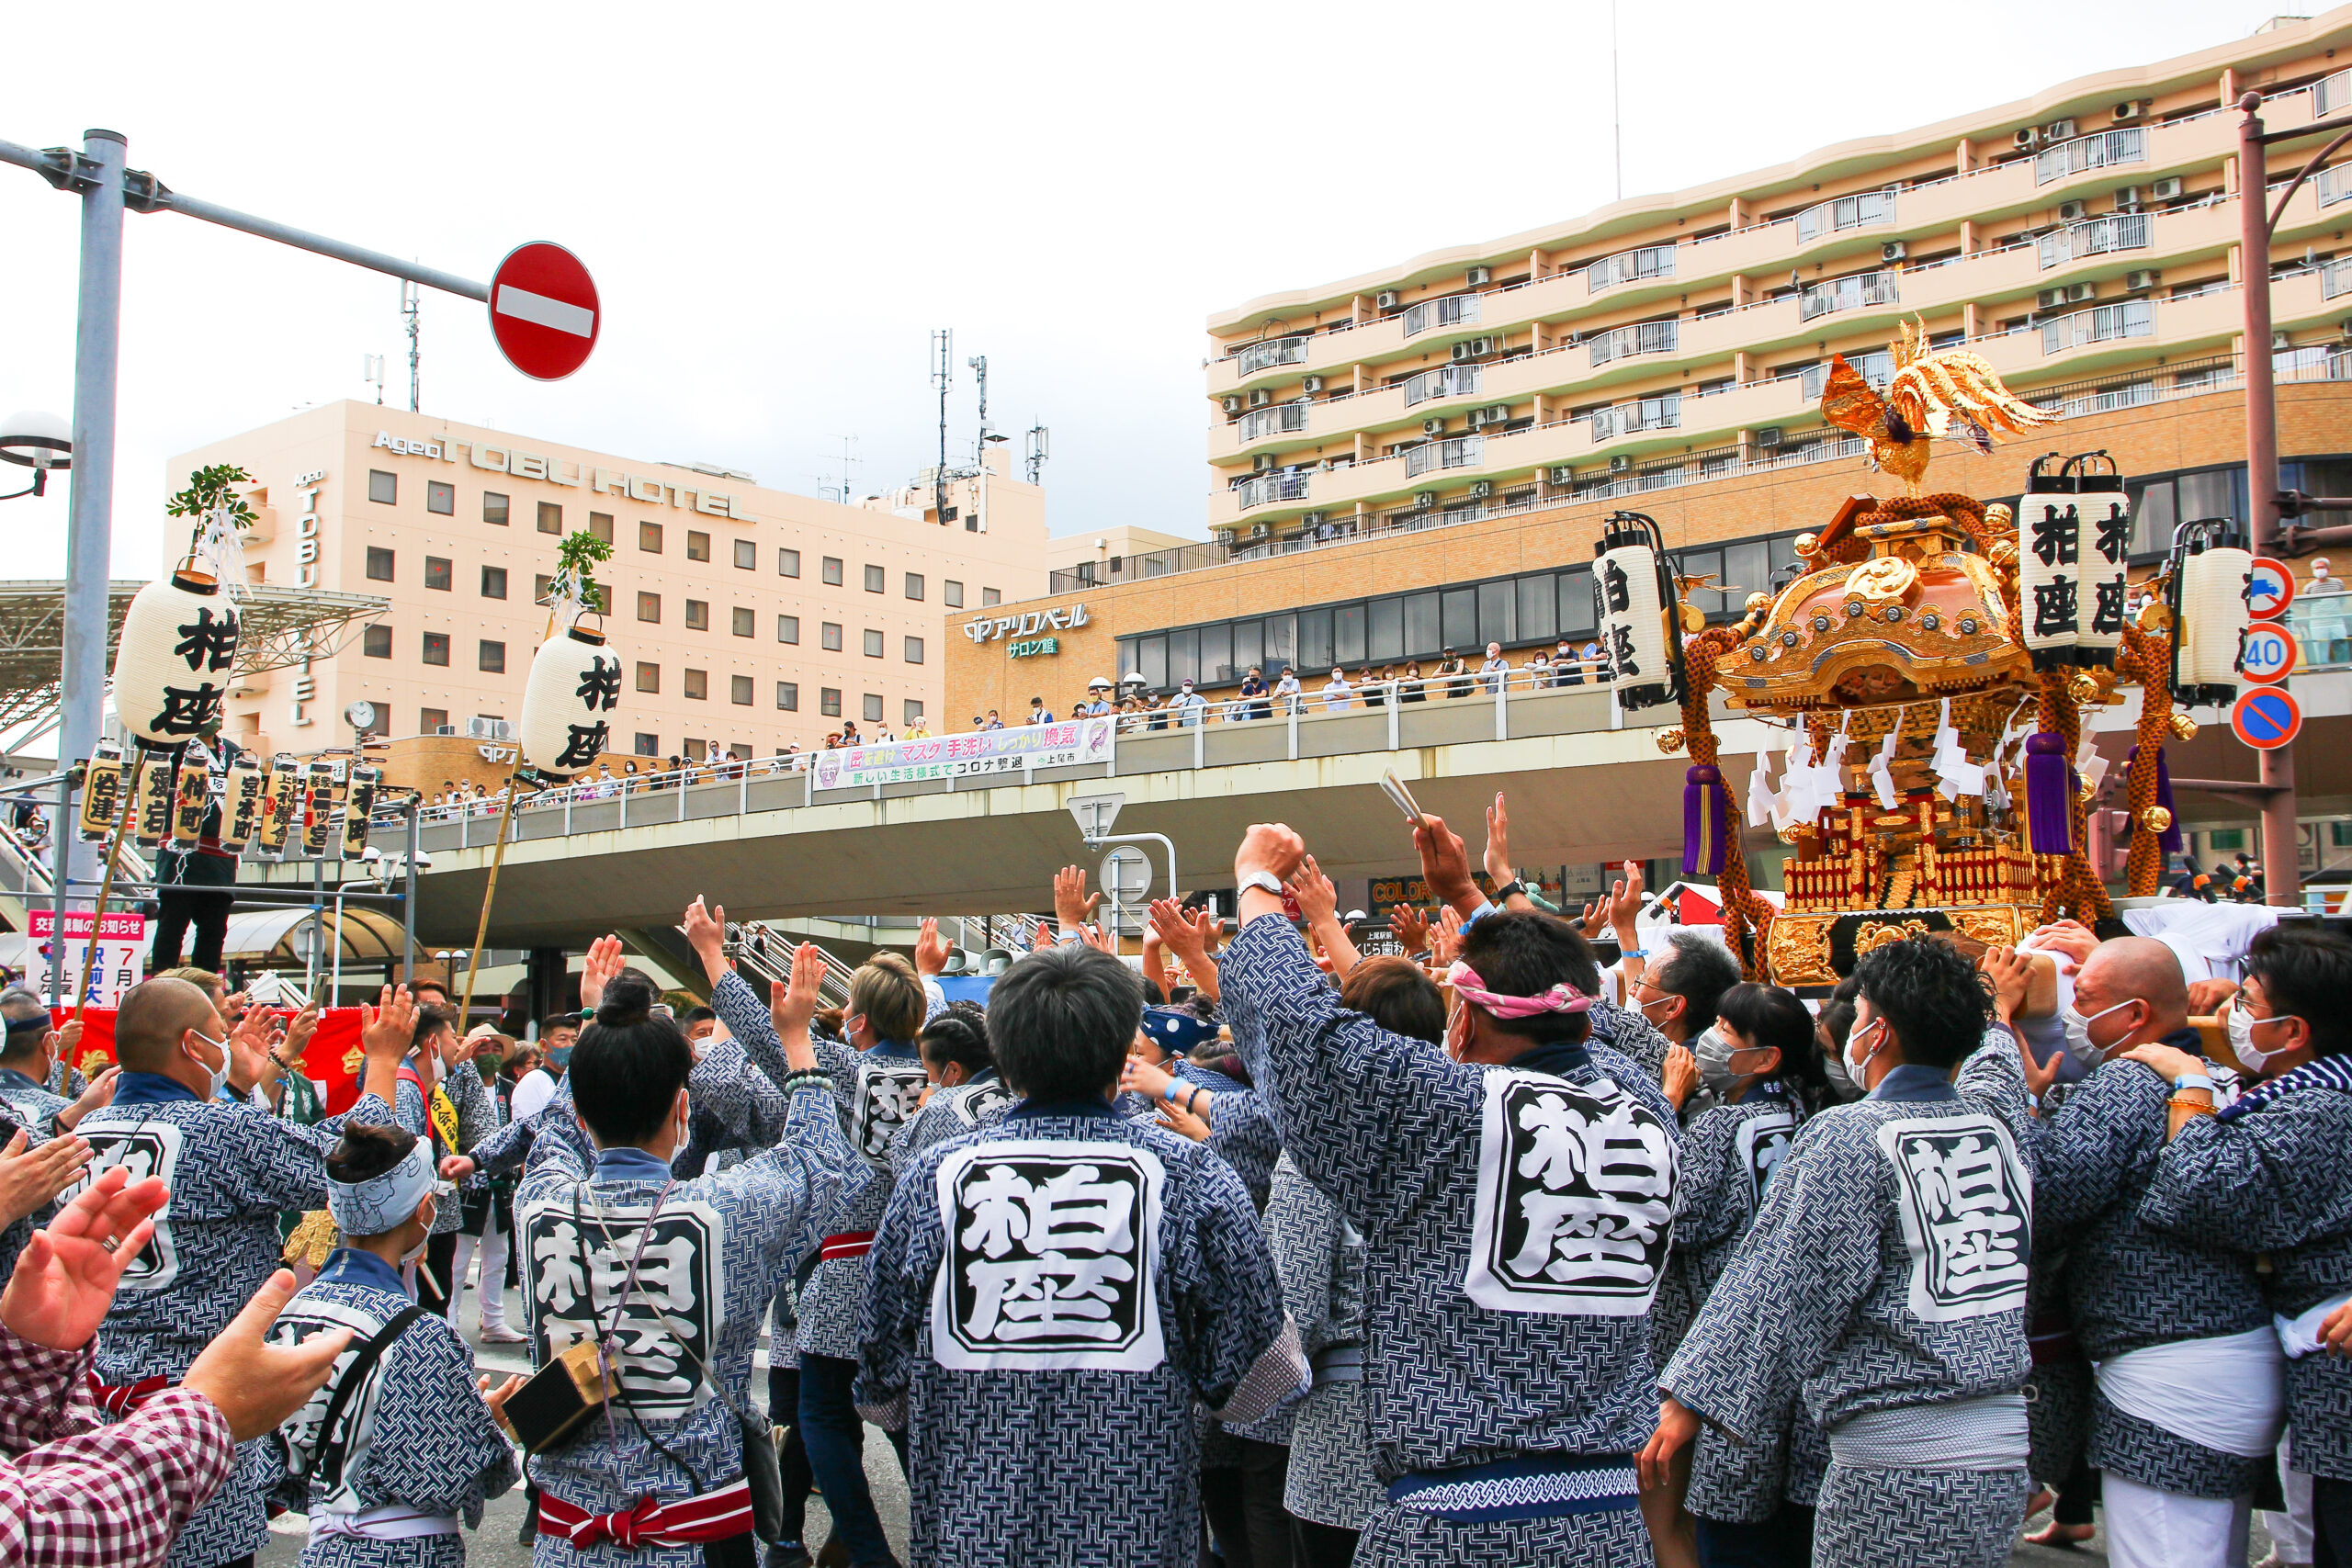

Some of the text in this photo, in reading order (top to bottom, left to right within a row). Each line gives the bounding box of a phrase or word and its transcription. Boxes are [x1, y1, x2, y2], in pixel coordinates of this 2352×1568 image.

[294, 469, 324, 488] Ageo
[370, 430, 758, 524] Ageo TOBU HOTEL
[295, 487, 319, 589] TOBU
[1007, 637, 1057, 659] サロン館
[2245, 638, 2283, 667] 40
[901, 742, 941, 761] マスク
[947, 736, 992, 759] 手洗い
[1047, 752, 1076, 764] 上尾市
[232, 775, 260, 840] 宮本町
[1506, 1093, 1671, 1283] 柏座
[1908, 1136, 2029, 1295] 柏座
[961, 1164, 1136, 1342] 柏座
